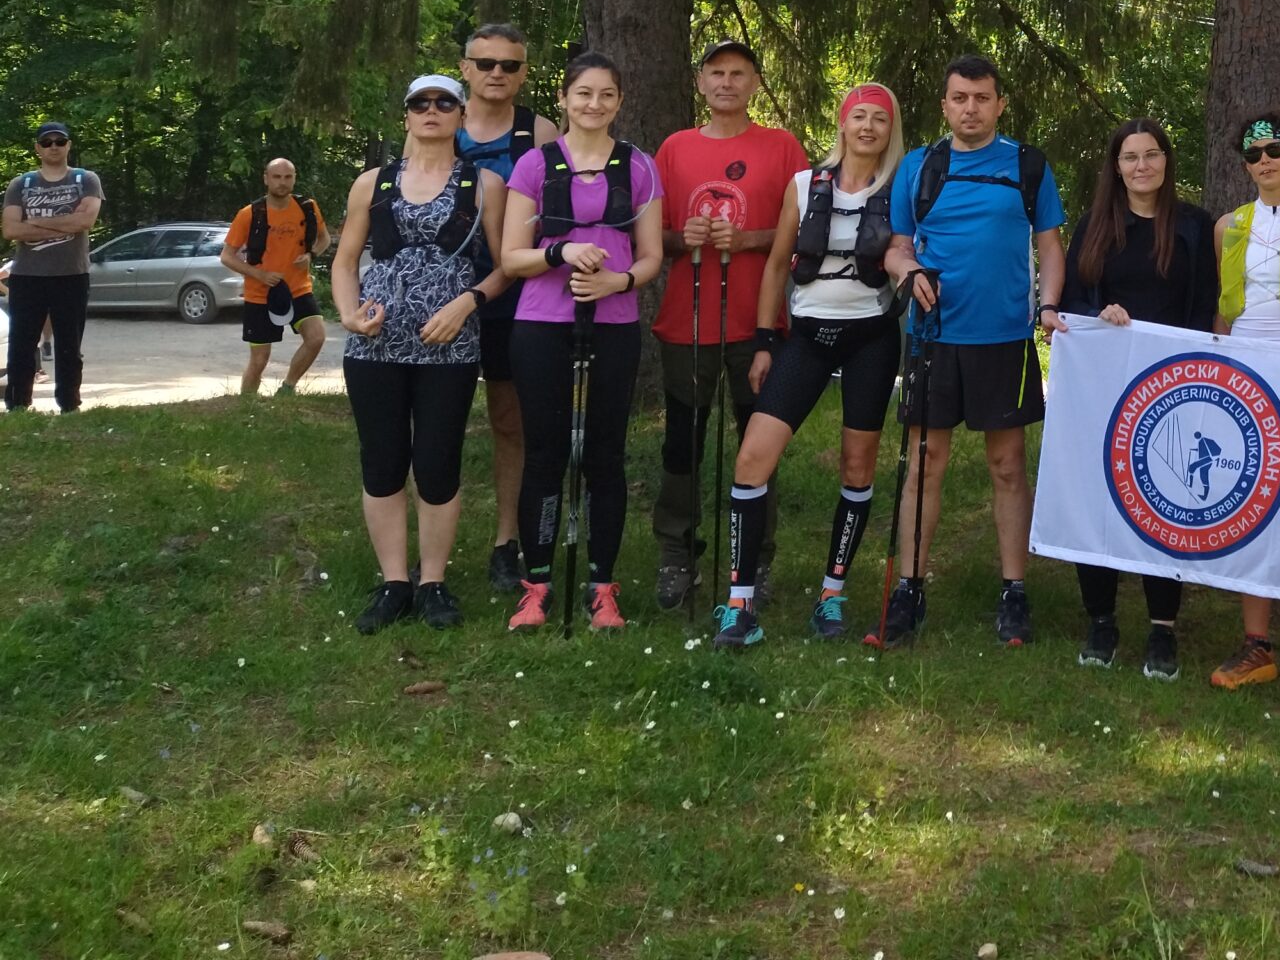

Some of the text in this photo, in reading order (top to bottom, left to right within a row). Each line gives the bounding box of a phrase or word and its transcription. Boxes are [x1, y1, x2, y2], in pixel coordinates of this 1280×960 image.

[1115, 364, 1280, 482] ПЛАНИНАРСКИ КЛУБ ВУКАН
[1134, 388, 1259, 477] MOUNTAINEERING CLUB VUKAN
[1139, 474, 1194, 523] POŽAREVAC
[1204, 492, 1244, 521] SERBIA
[1214, 457, 1241, 471] 1960
